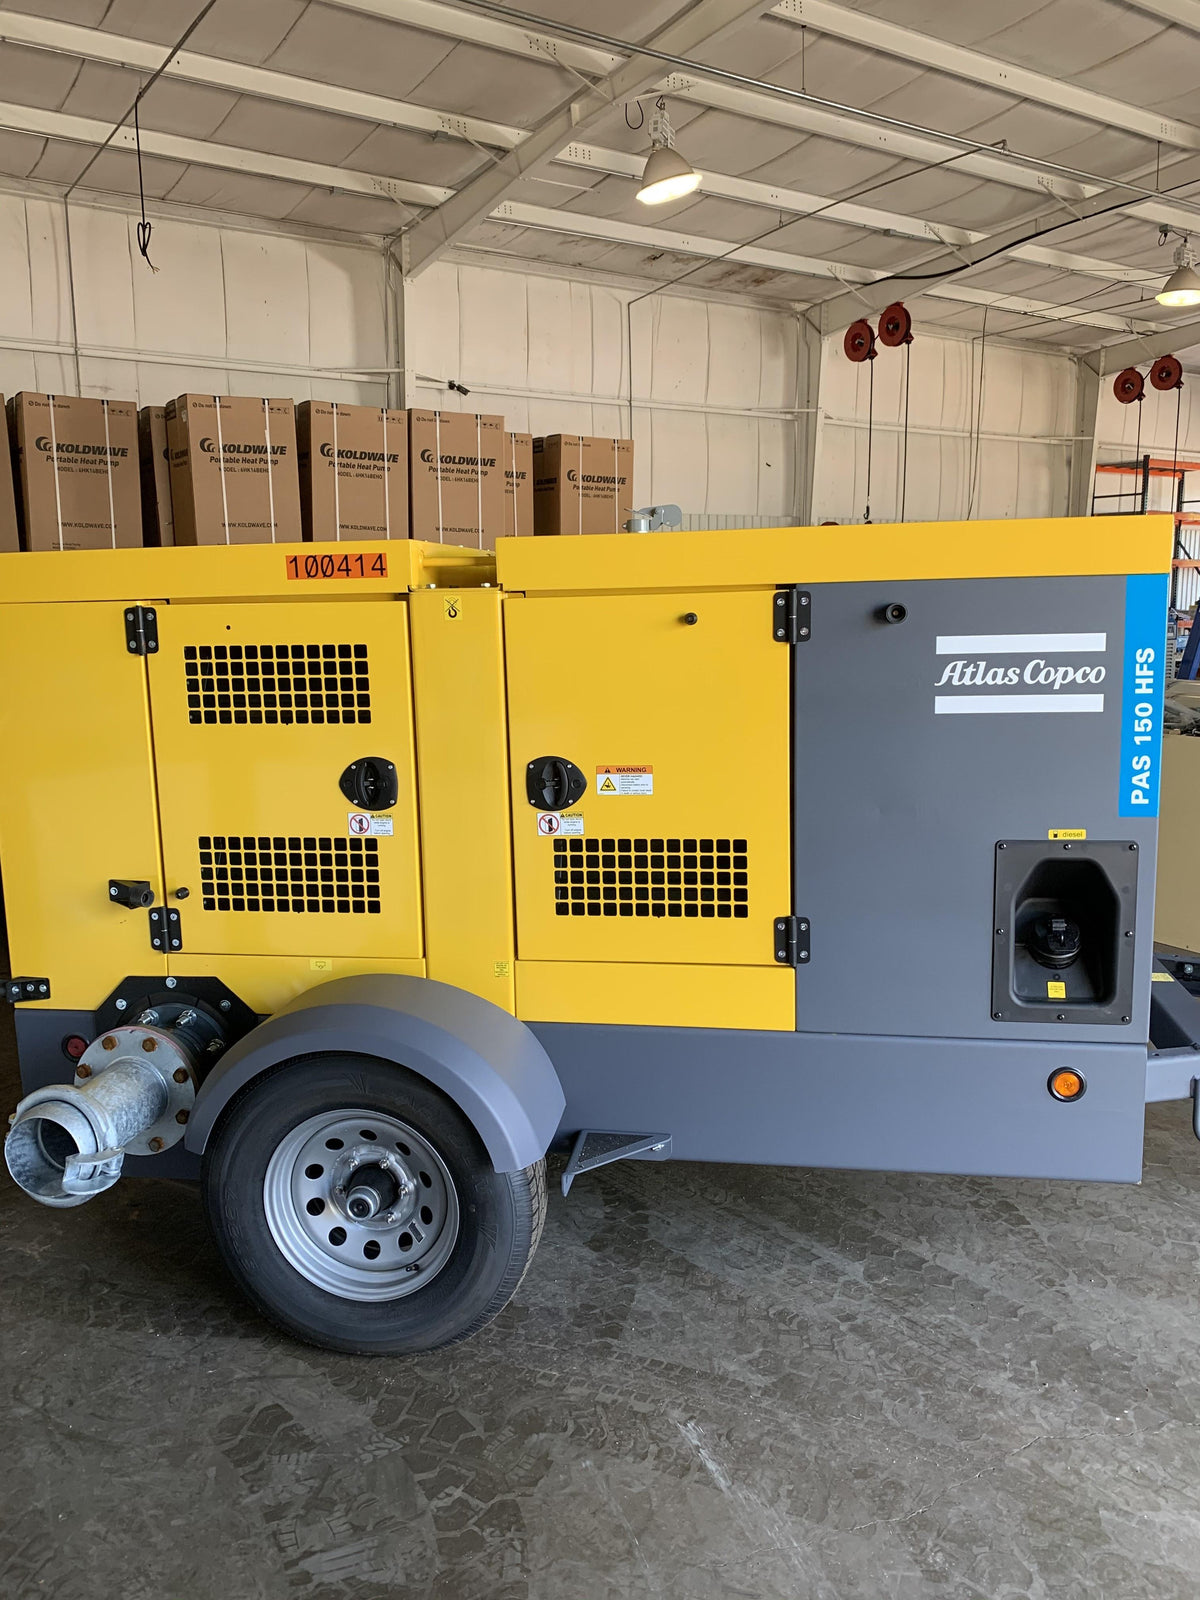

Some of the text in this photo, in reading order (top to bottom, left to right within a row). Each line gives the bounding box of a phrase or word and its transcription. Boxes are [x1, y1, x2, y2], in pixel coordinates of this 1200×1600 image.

[55, 443, 128, 457] KOLDWAVE
[218, 443, 287, 456] KOLDWAVE
[337, 449, 400, 463] KOLDWAVE
[79, 457, 97, 466] Heat
[98, 459, 120, 469] Pump
[241, 457, 258, 465] Heat
[258, 458, 279, 467] Pump
[357, 463, 373, 471] Heat
[437, 454, 497, 467] KOLDWAVE
[455, 467, 471, 475] Heat
[471, 469, 488, 477] Pump
[506, 481, 520, 489] Pup
[581, 474, 627, 485] KOLDWAVE
[289, 553, 386, 578] 100414
[934, 659, 1106, 689] Atlas Copco
[1131, 647, 1155, 804] PAS 150 HFS
